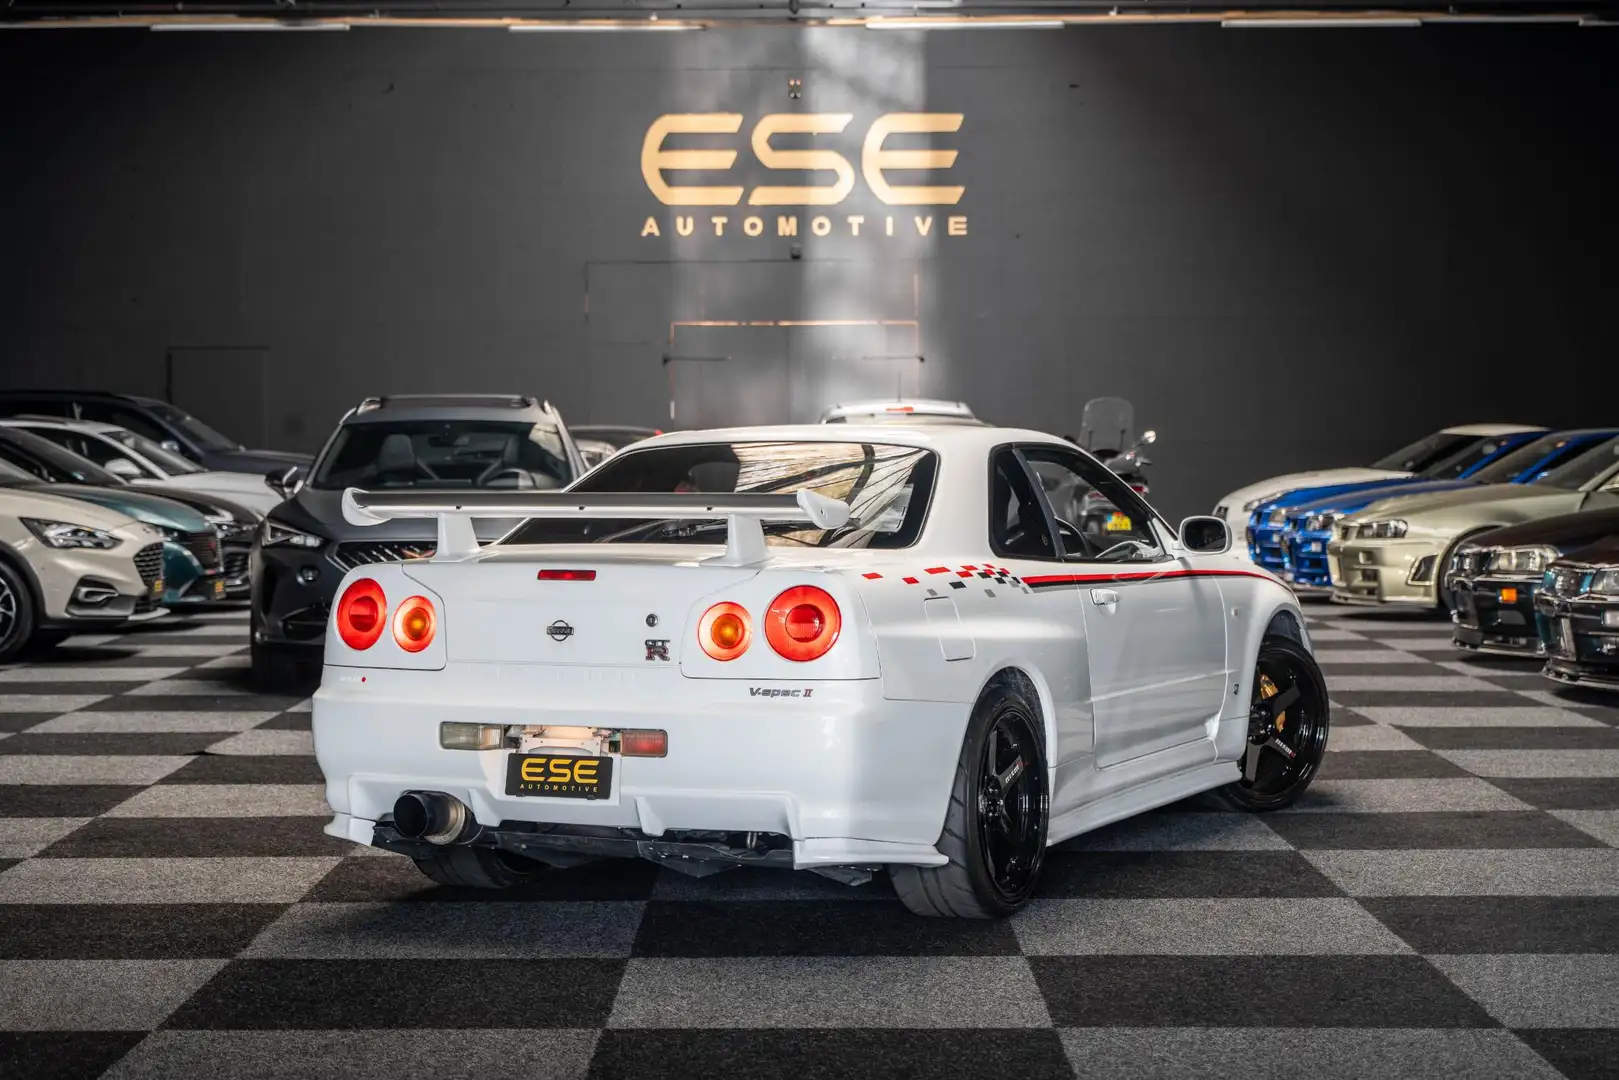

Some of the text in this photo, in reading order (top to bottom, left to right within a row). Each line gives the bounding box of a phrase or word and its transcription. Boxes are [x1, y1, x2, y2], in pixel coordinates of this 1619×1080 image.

[641, 112, 965, 206] ESE
[641, 215, 968, 237] AUTOMOTIVE
[521, 757, 600, 784] ESE
[519, 783, 598, 793] AUTOMOTIVE
